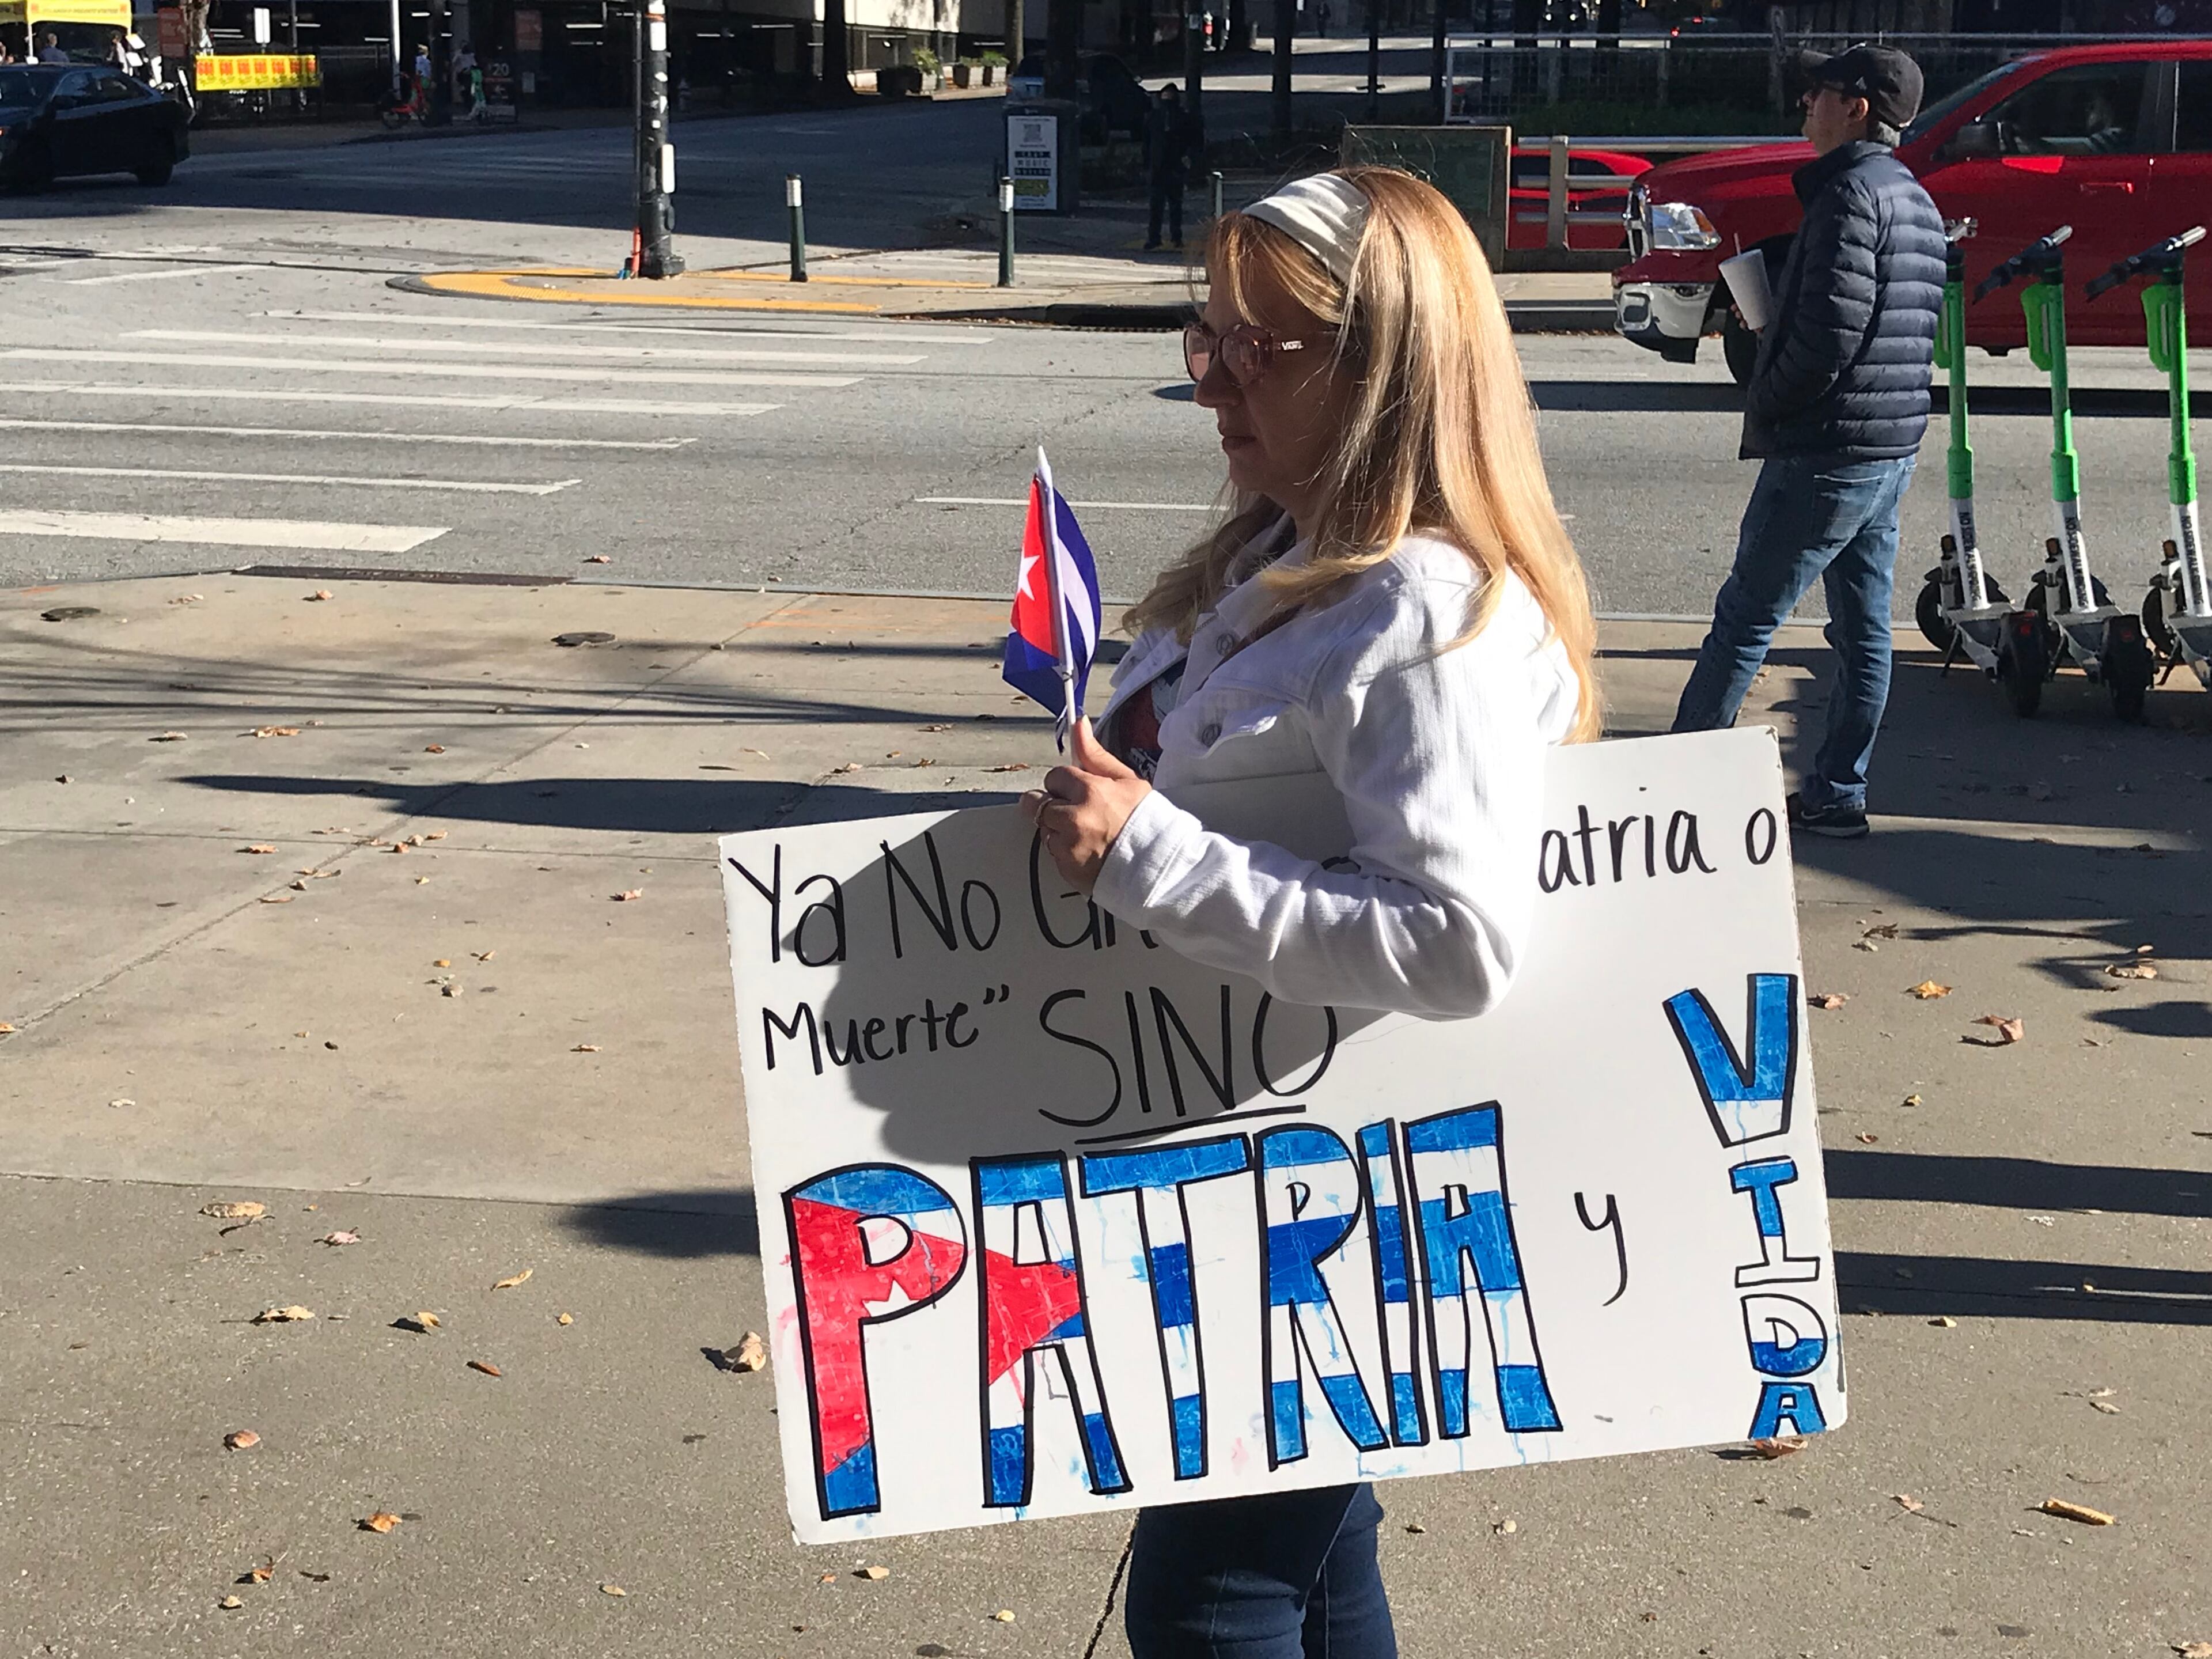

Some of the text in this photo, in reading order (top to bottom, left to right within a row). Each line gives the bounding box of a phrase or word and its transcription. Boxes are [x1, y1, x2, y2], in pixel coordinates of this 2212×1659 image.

[728, 843, 846, 967] Ya
[880, 831, 1001, 959] No
[1537, 786, 1718, 894] atria
[1039, 984, 1338, 1127] SINO
[1662, 972, 1828, 1440] VIDA
[782, 1100, 1627, 1521] PATRIA y
